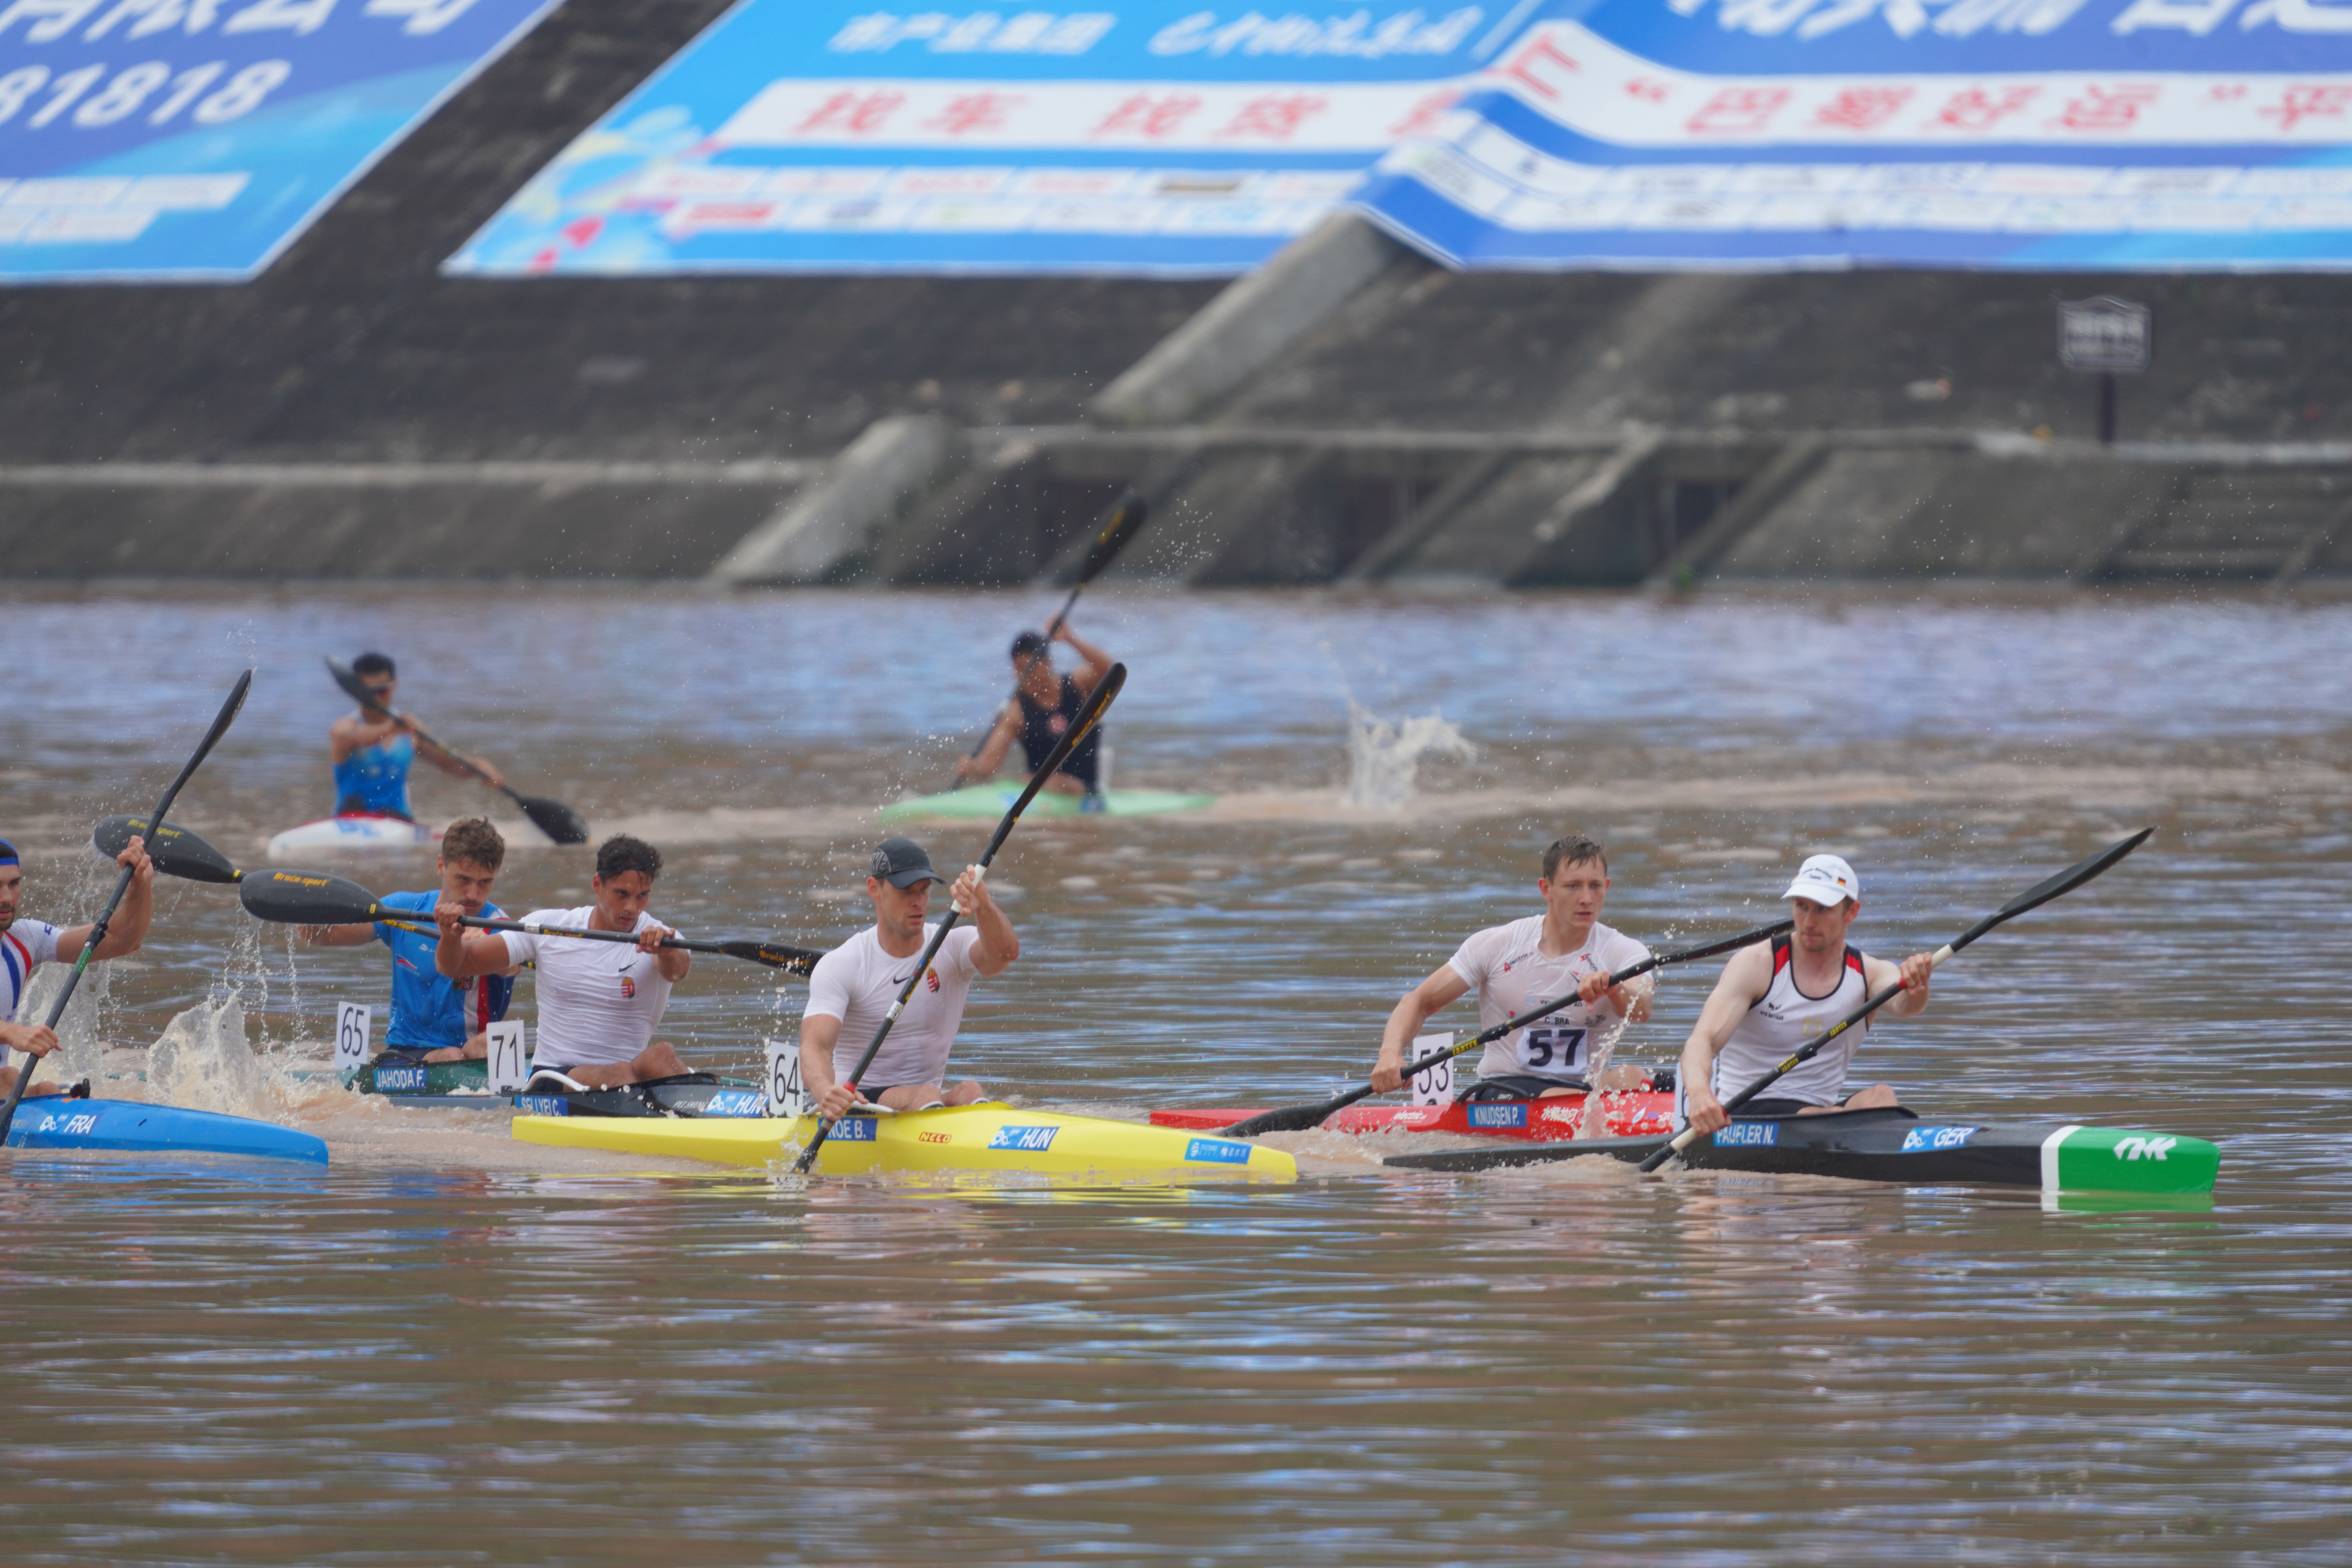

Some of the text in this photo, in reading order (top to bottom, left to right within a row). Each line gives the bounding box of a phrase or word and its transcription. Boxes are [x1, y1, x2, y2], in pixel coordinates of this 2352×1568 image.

[341, 1006, 364, 1056] 65
[492, 1032, 518, 1079] 71
[1528, 1029, 1586, 1067] 57
[377, 1069, 424, 1087] JAHODA F.
[775, 1053, 800, 1107] 64
[1419, 1046, 1449, 1095] 53
[552, 1099, 562, 1117] C.
[732, 1095, 769, 1114] HUN
[64, 1115, 96, 1134] FRA
[1474, 1106, 1511, 1125] KNUDSEN
[1512, 1106, 1520, 1125] P.
[854, 1119, 866, 1139] B.
[920, 1132, 951, 1143] NELO
[1017, 1128, 1056, 1148] HUN
[1717, 1124, 1774, 1144] PAUFLER N.
[1934, 1128, 1974, 1147] GER
